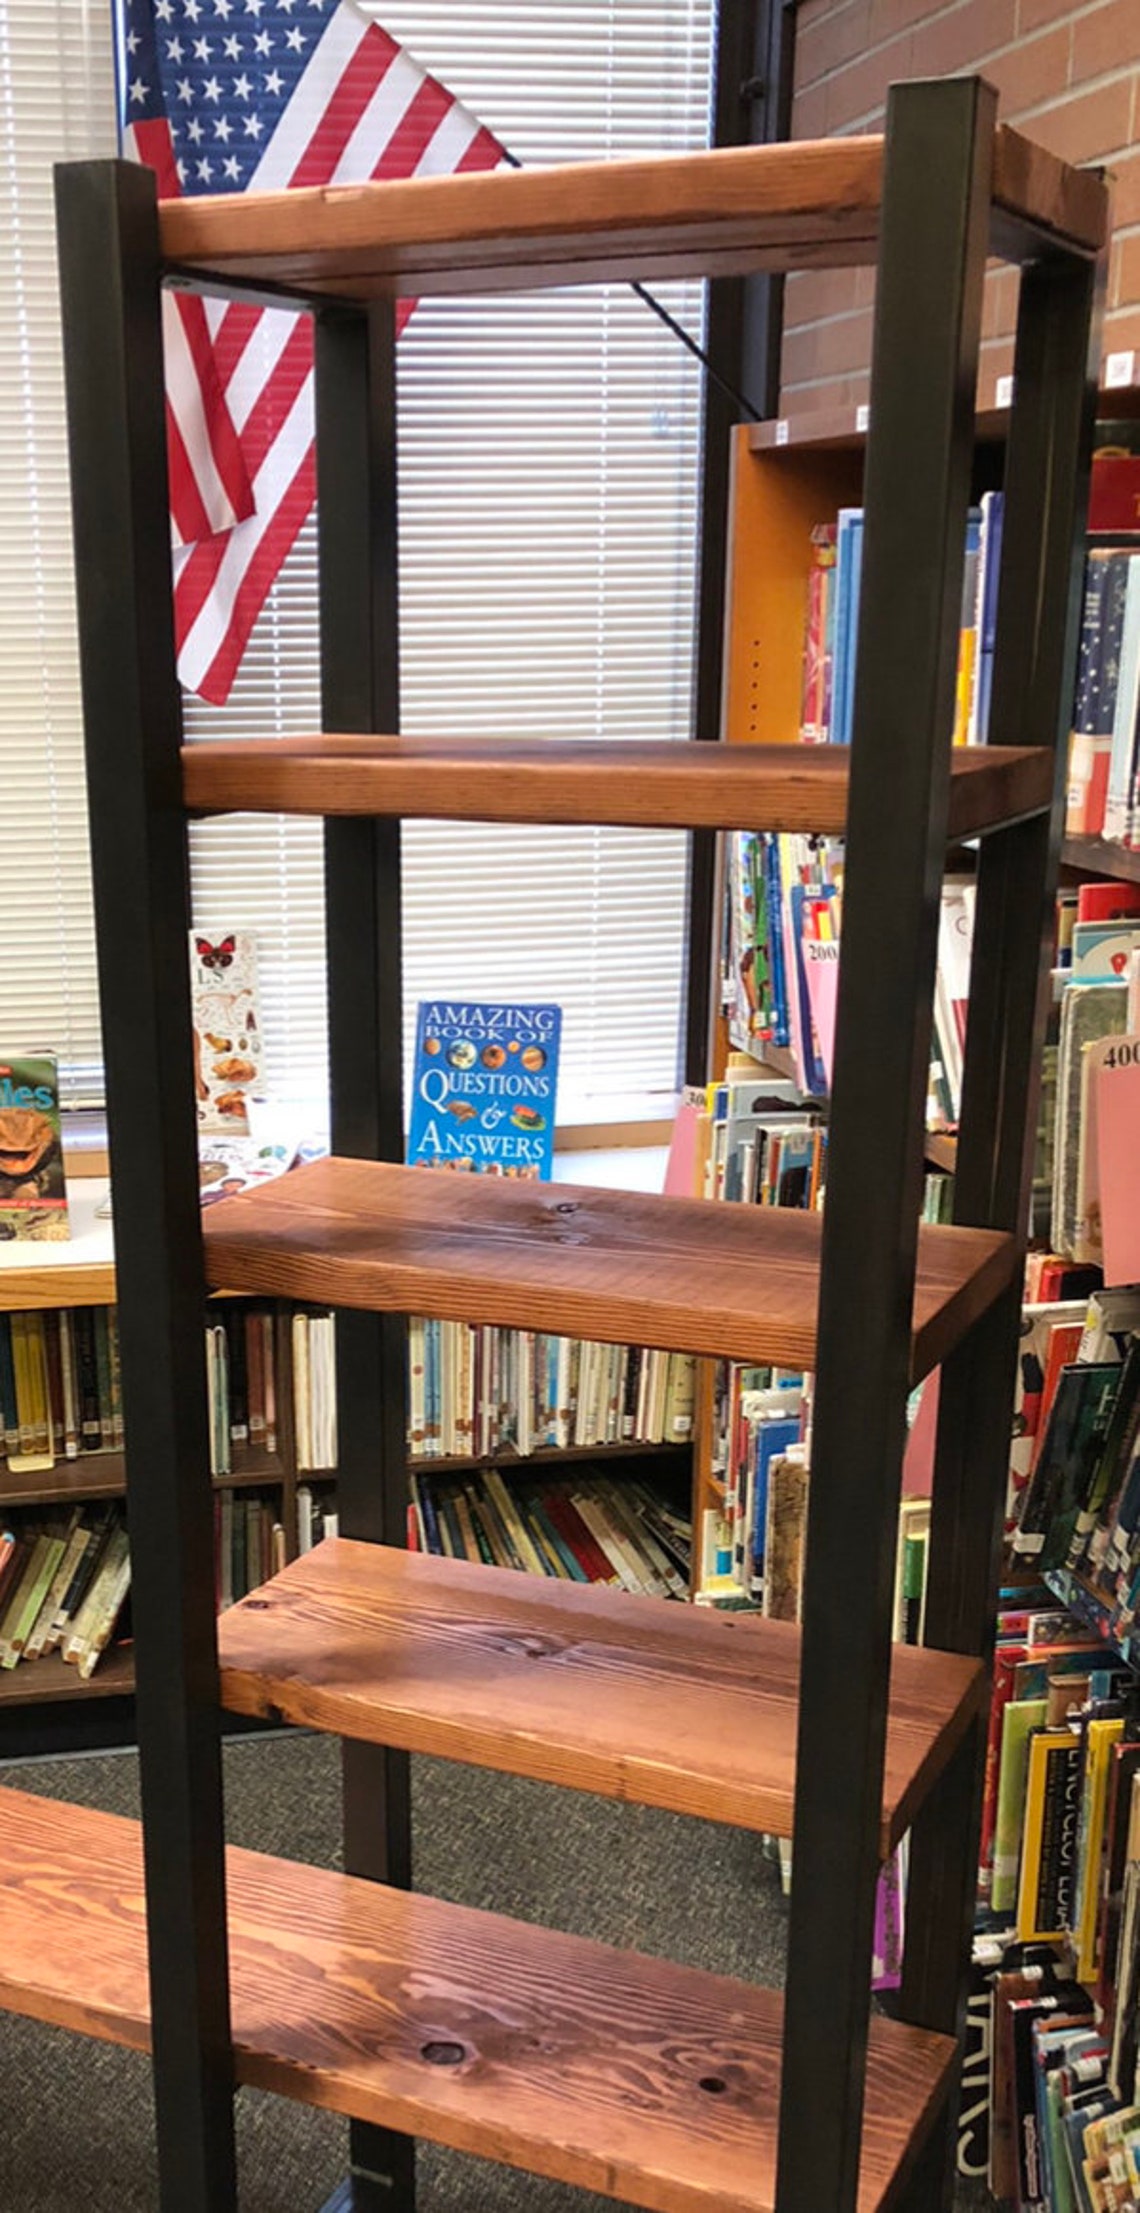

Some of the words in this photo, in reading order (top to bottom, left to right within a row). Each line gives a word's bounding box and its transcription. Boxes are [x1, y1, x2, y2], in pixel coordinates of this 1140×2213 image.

[808, 944, 838, 961] 200
[426, 1005, 554, 1031] AMAZING
[426, 1027, 506, 1041] BOOK
[516, 1028, 553, 1043] OF
[420, 1068, 550, 1114] QUESTIONS
[684, 1091, 708, 1107] 30
[480, 1101, 508, 1129] &
[417, 1120, 545, 1159] ANSWERS
